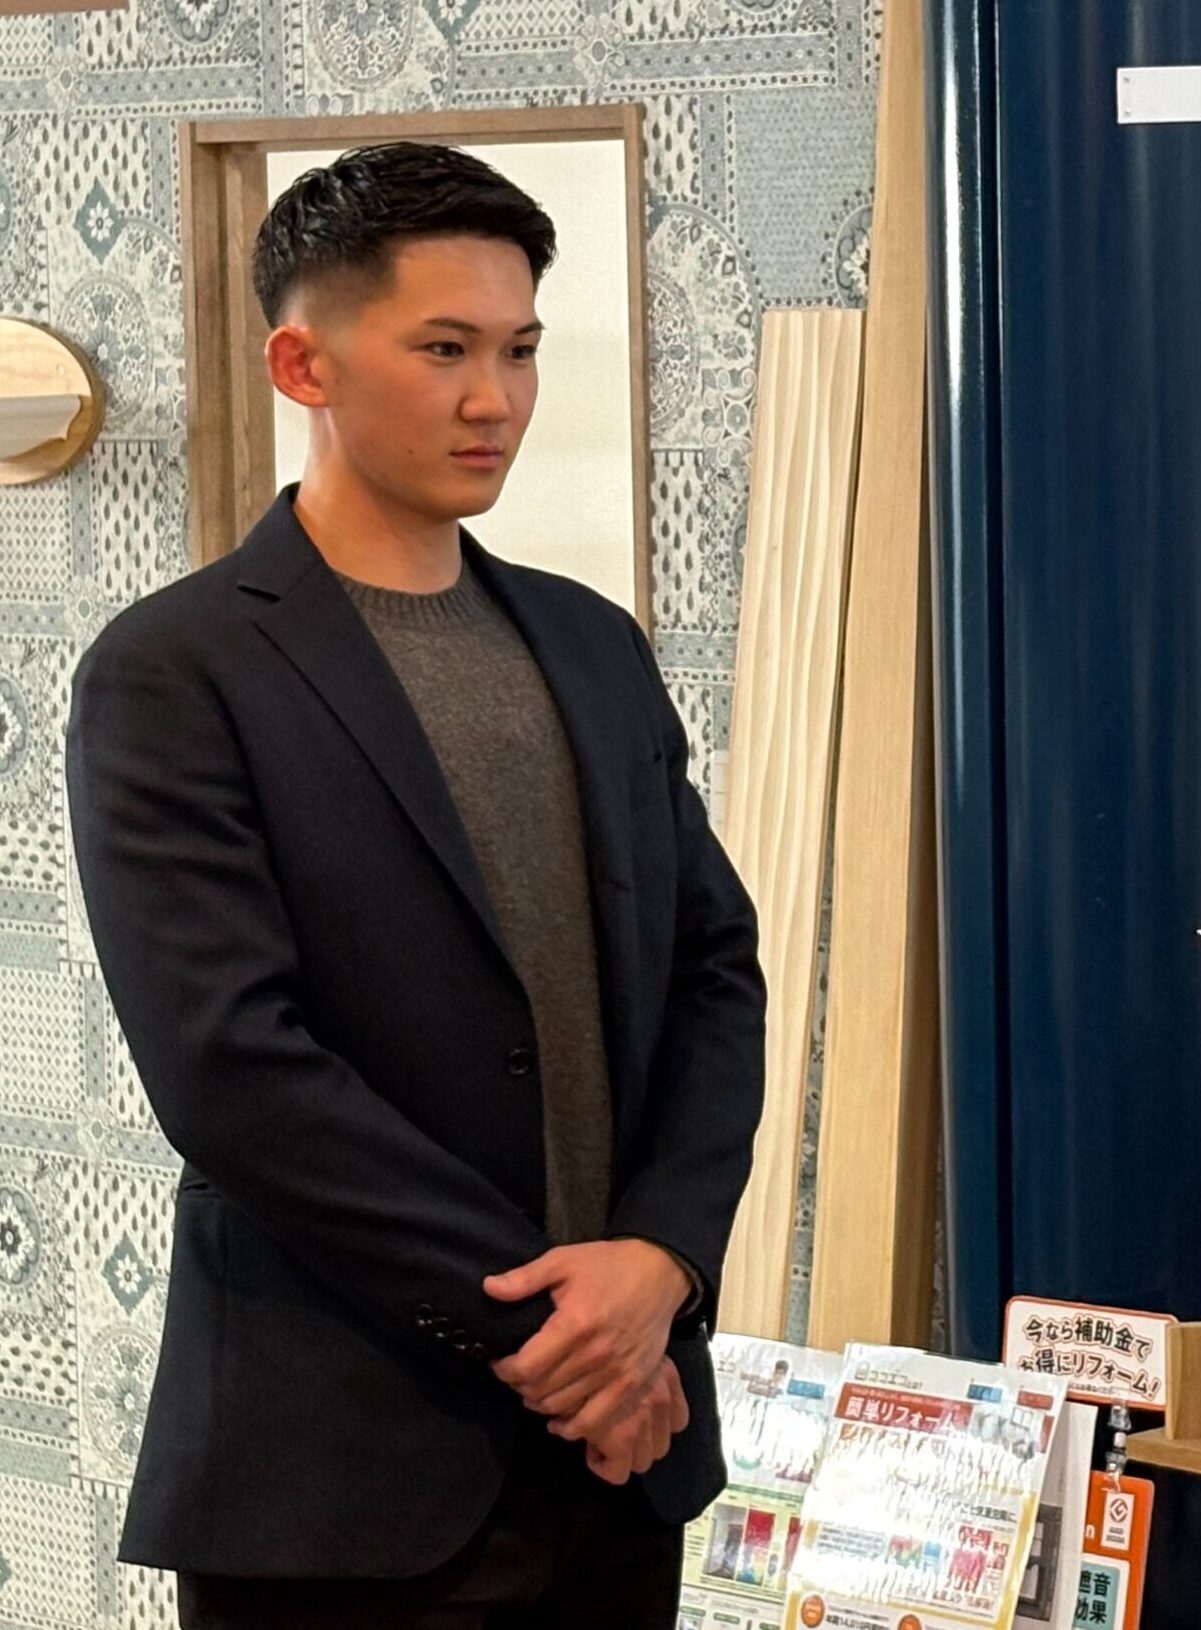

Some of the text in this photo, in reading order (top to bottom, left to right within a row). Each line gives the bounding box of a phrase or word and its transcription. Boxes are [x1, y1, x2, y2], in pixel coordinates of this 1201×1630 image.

[1026, 1315, 1150, 1358] 今なら補助金で
[844, 1396, 957, 1434] 簡単リフォーム
